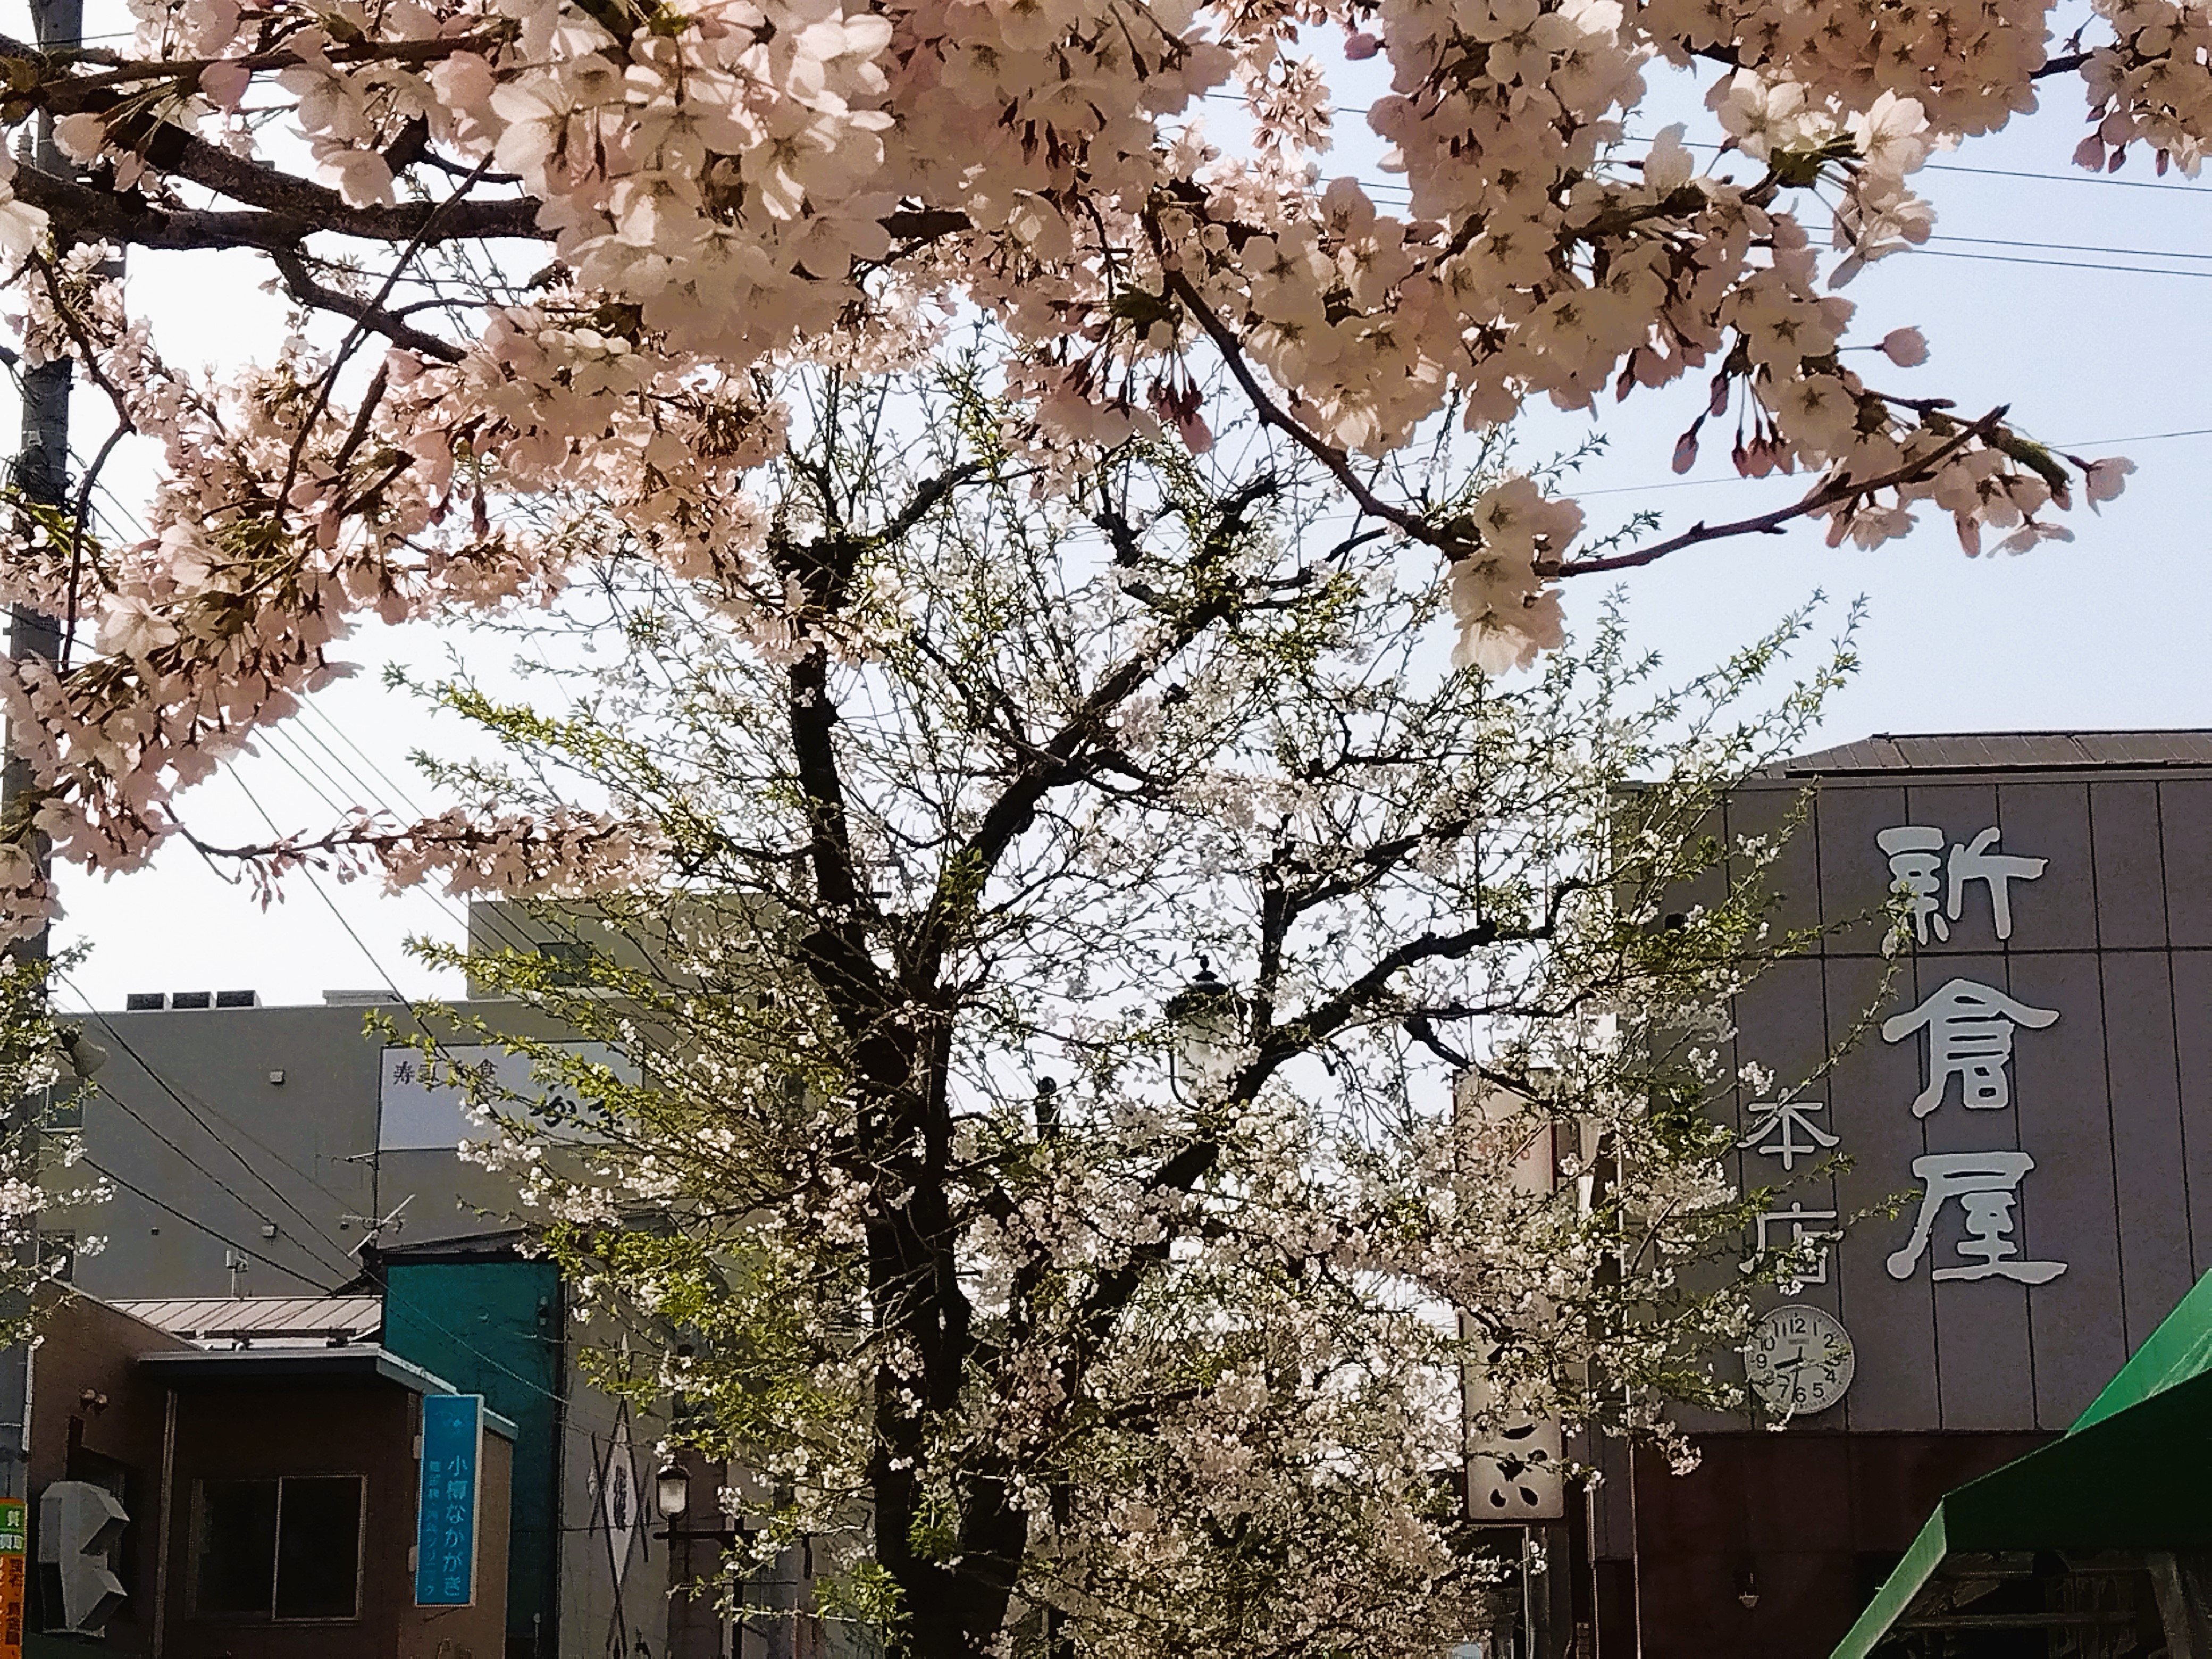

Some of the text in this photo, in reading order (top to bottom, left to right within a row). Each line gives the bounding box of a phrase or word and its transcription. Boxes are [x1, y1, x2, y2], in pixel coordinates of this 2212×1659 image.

[1876, 826, 2068, 1284] 新倉屋
[1733, 1087, 1844, 1283] 本店
[1790, 1318, 1806, 1334] 12
[1813, 1322, 1817, 1336] 1
[1757, 1336, 1776, 1352] 10
[1824, 1333, 1839, 1349] 2
[1756, 1353, 1768, 1369] 9
[1778, 1384, 1789, 1398] 7
[1795, 1386, 1807, 1403] 6
[1812, 1382, 1825, 1398] 5
